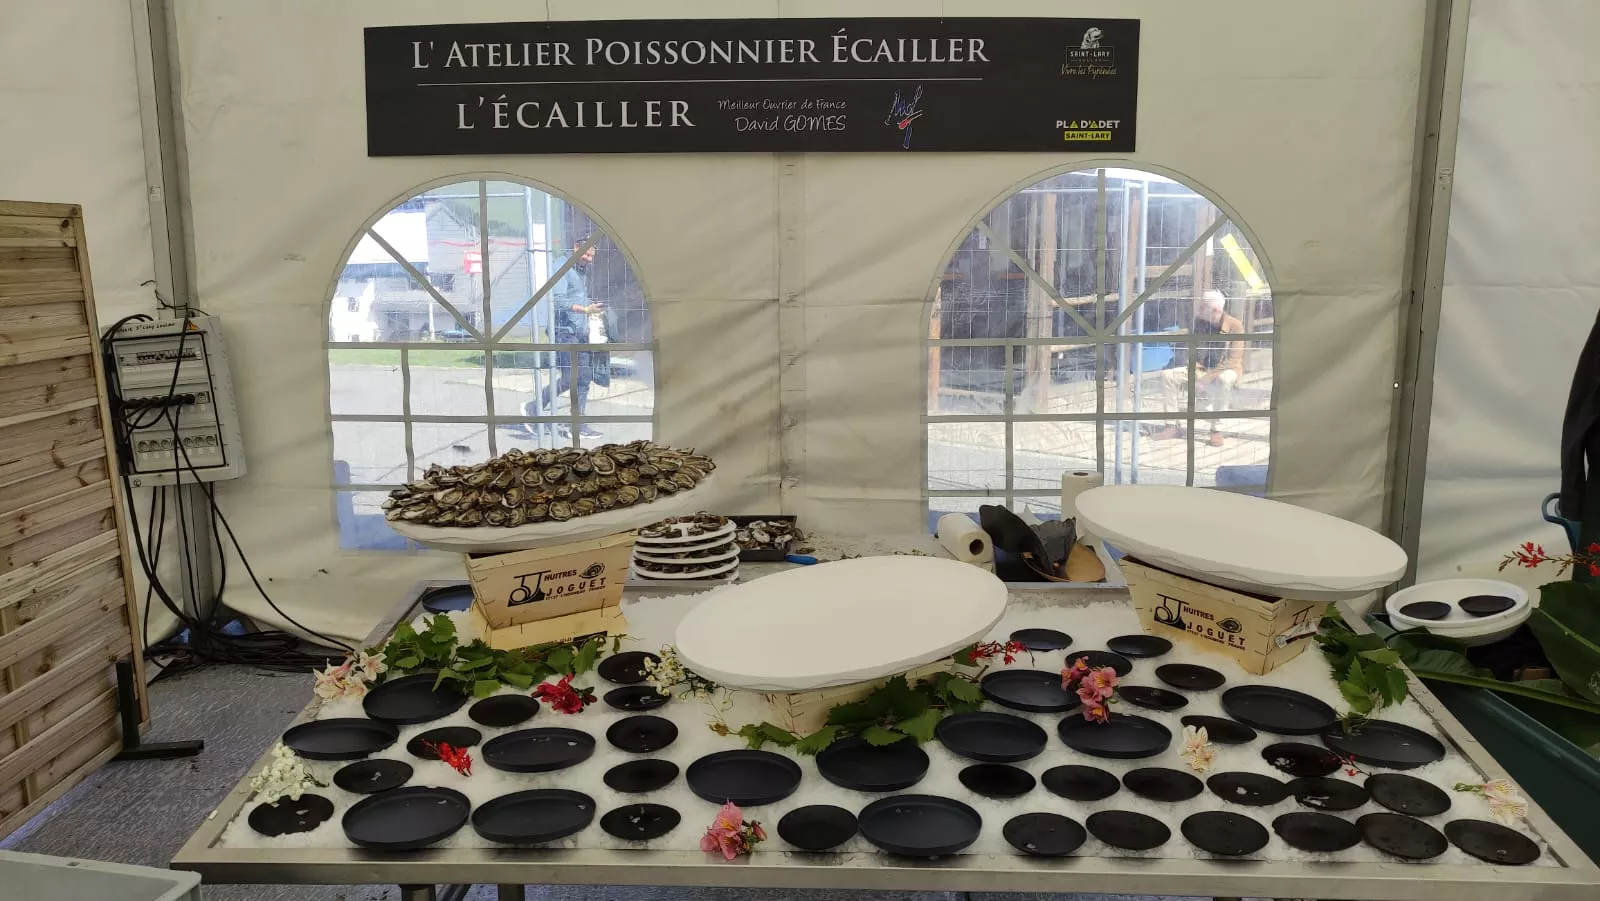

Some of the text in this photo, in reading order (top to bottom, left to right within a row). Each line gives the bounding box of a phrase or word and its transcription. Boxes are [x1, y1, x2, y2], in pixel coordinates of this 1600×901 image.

[456, 94, 697, 130] L'ÉCAILLER
[717, 98, 847, 110] Meilleur Ouvrier de France
[734, 114, 847, 132] David GOMES
[1065, 131, 1111, 140] SAINT-LARY
[544, 569, 577, 582] HUITRES
[546, 577, 607, 597] JOGUET
[1183, 606, 1215, 621] HUITRES
[1187, 622, 1246, 646] JOGUET
